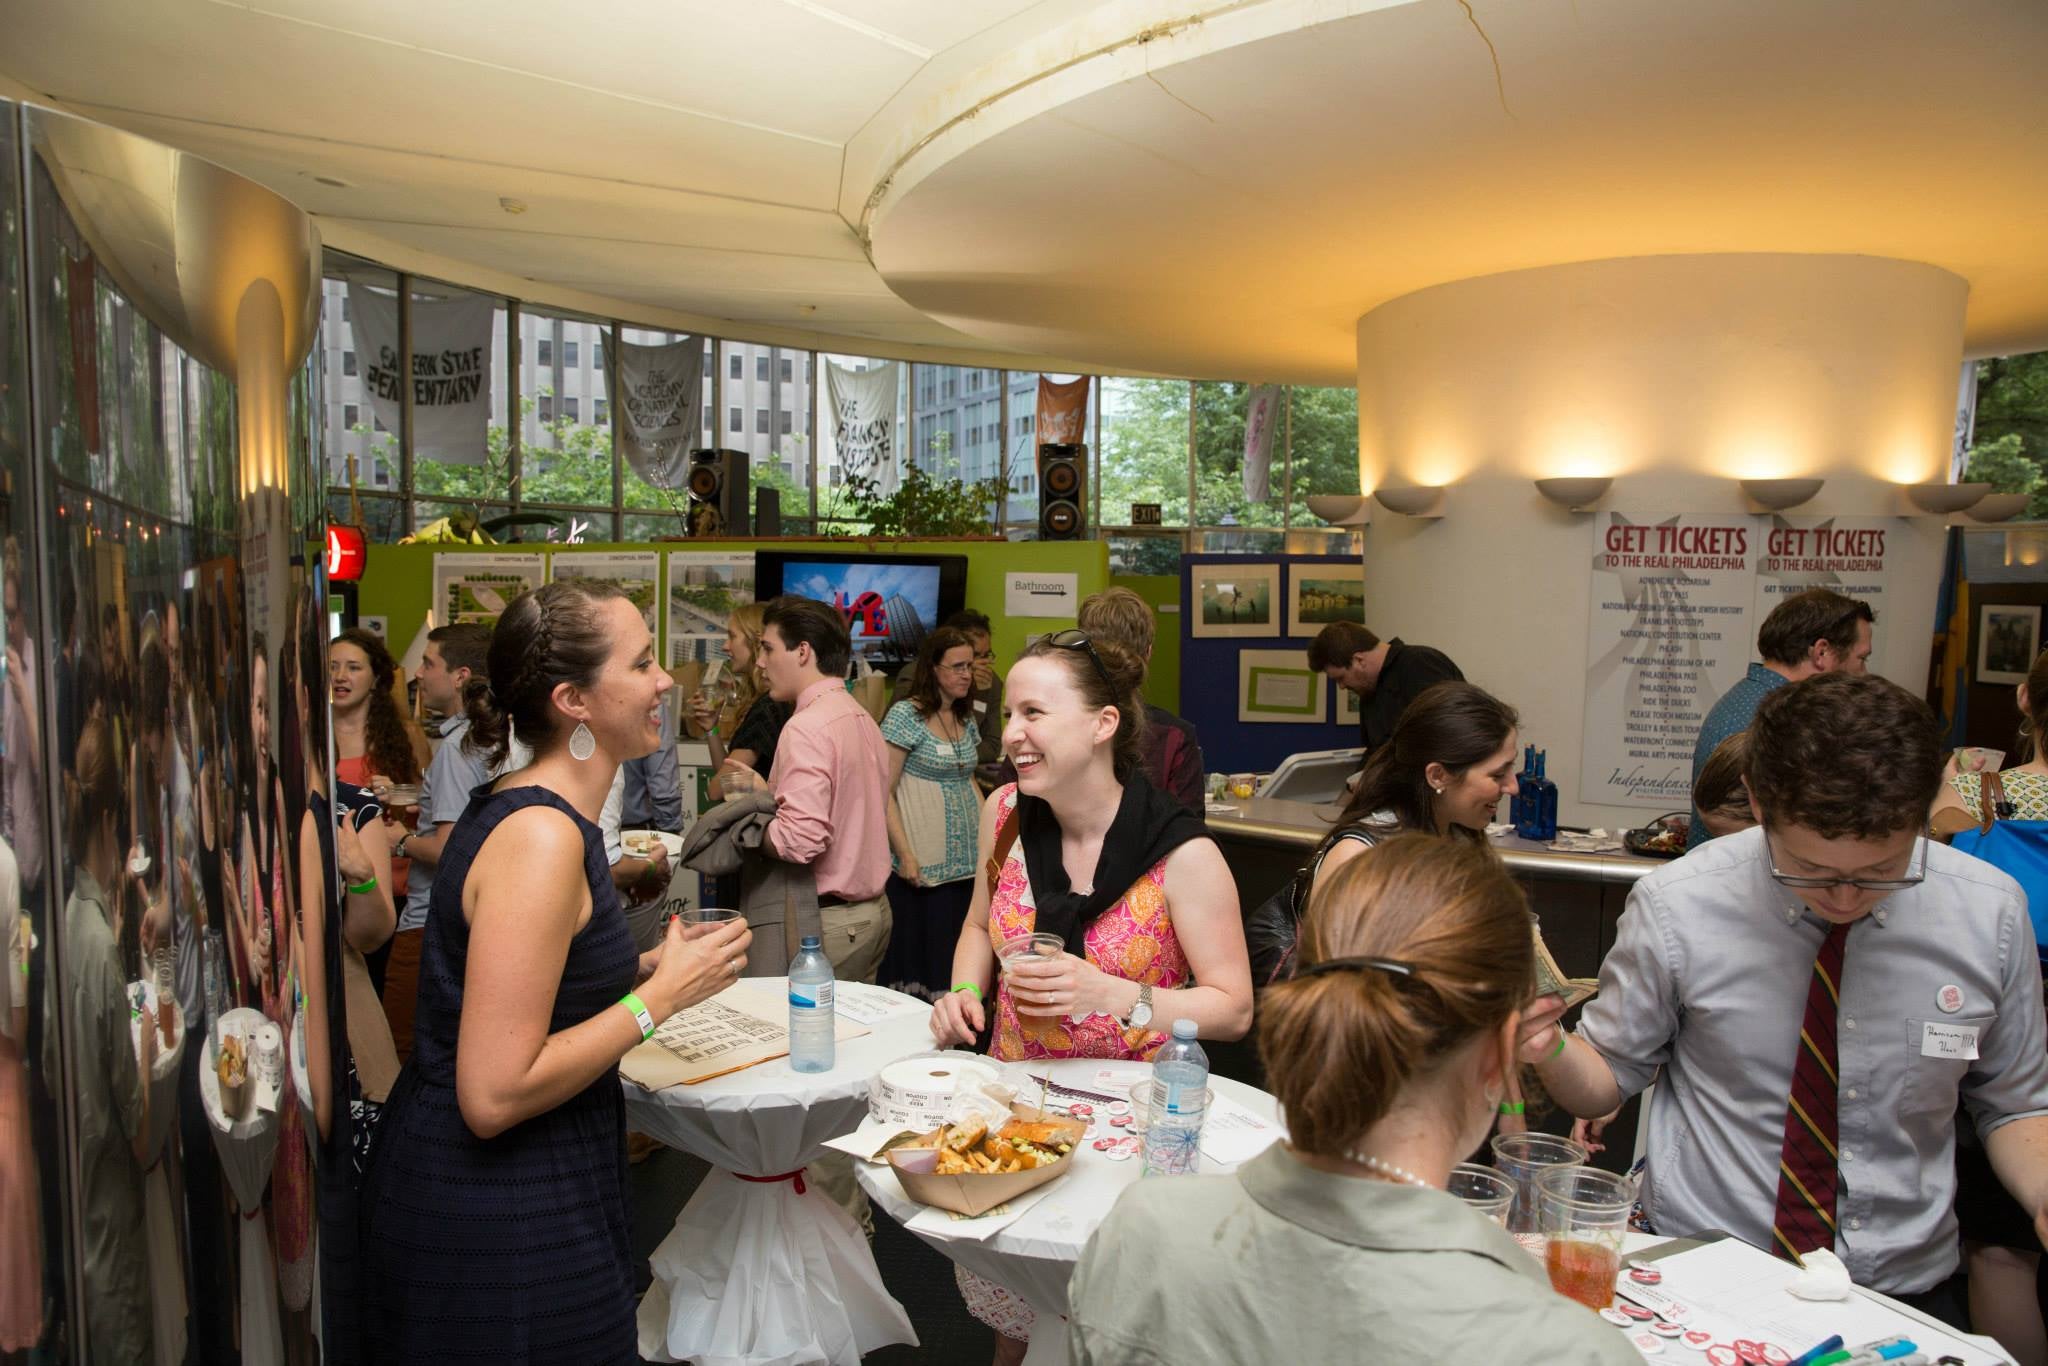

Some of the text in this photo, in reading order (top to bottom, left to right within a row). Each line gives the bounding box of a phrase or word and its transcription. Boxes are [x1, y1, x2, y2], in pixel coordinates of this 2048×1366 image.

[381, 345, 437, 376] EAERN
[368, 364, 482, 406] PENENTIARY
[1133, 506, 1158, 522] EXIT
[1605, 525, 1747, 555] GET TICKETS
[1767, 528, 1885, 557] GET TICKETS
[1605, 554, 1745, 570] TO THE REAL PHILADELPHIA
[1767, 558, 1883, 572] TO THE REAL PHILADELPHIA
[1015, 580, 1065, 591] Bathroom
[1683, 686, 1697, 694] ZOO
[1667, 751, 1695, 760] PROGRA
